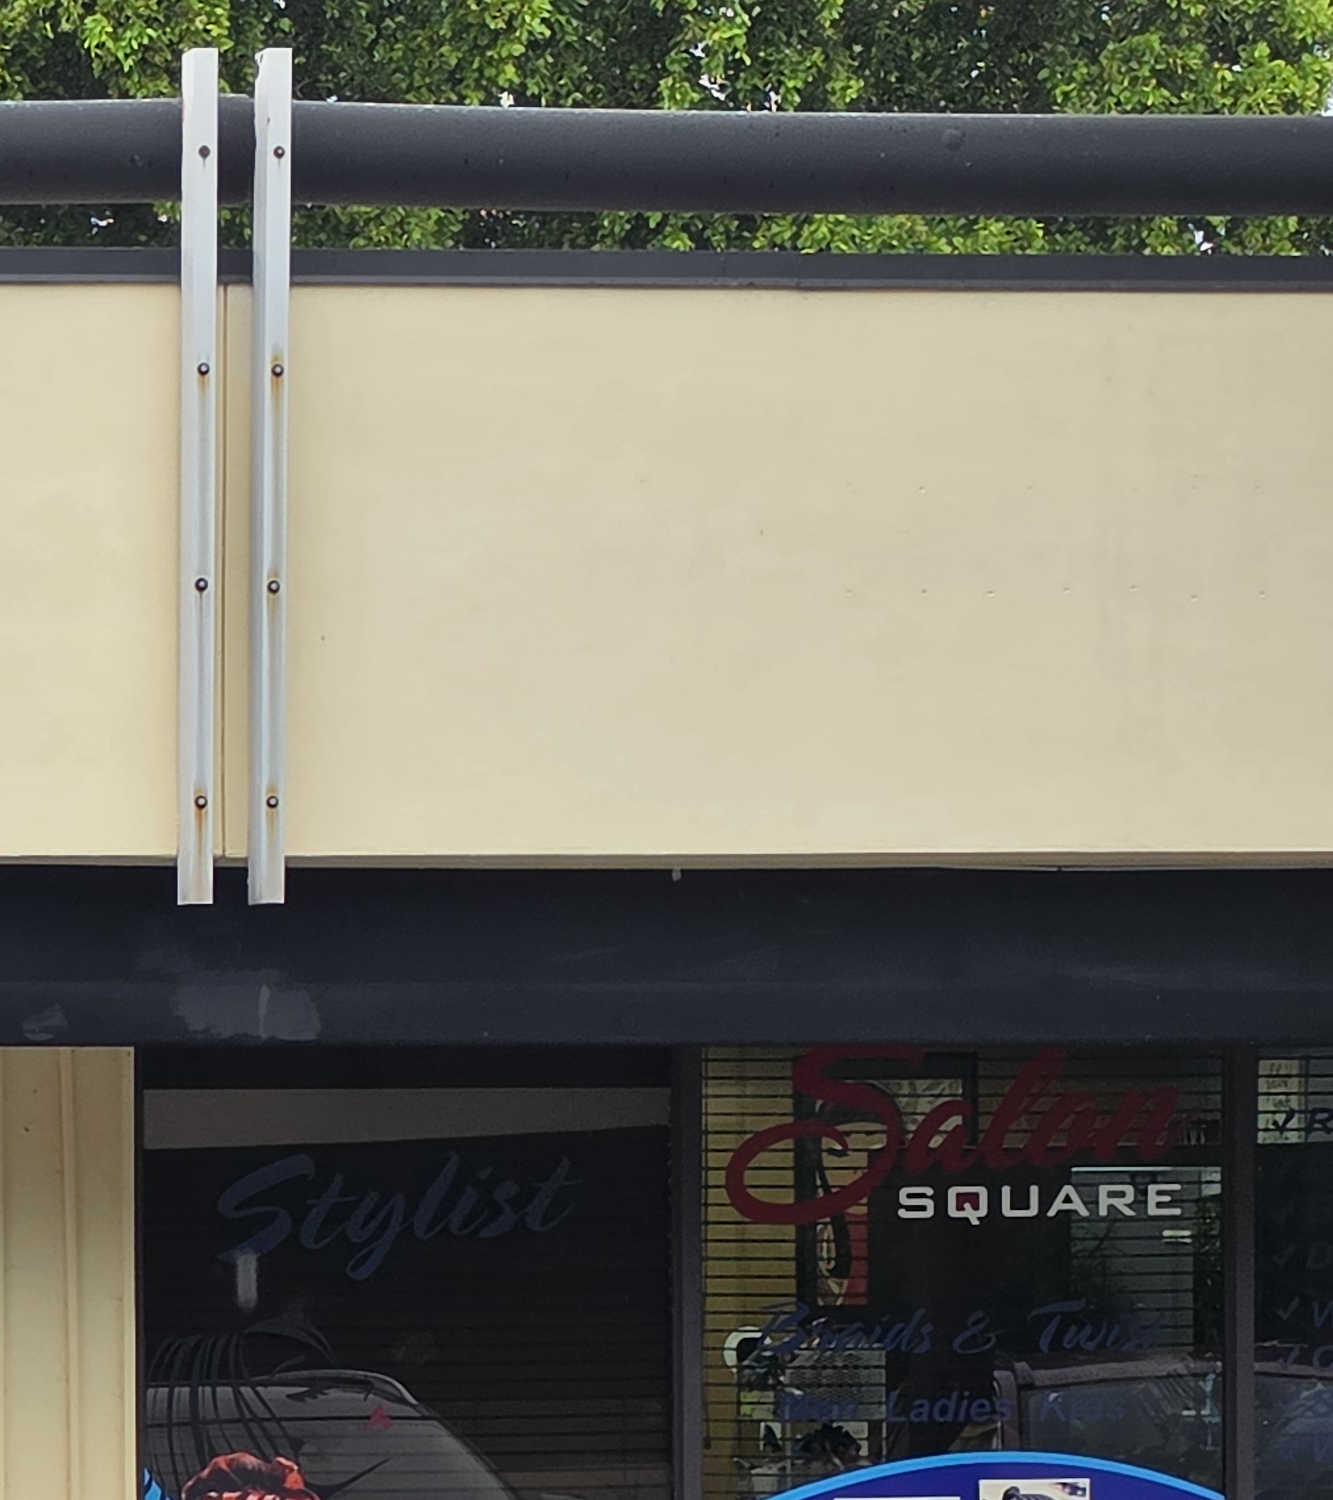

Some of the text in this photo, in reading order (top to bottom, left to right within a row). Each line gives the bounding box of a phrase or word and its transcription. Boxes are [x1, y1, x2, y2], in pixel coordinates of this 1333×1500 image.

[726, 1045, 1191, 1224] Salon
[216, 1152, 582, 1281] Stylist
[897, 1183, 1184, 1226] SQUARE
[952, 1310, 1005, 1355] &
[886, 1388, 1013, 1424] Ladies
